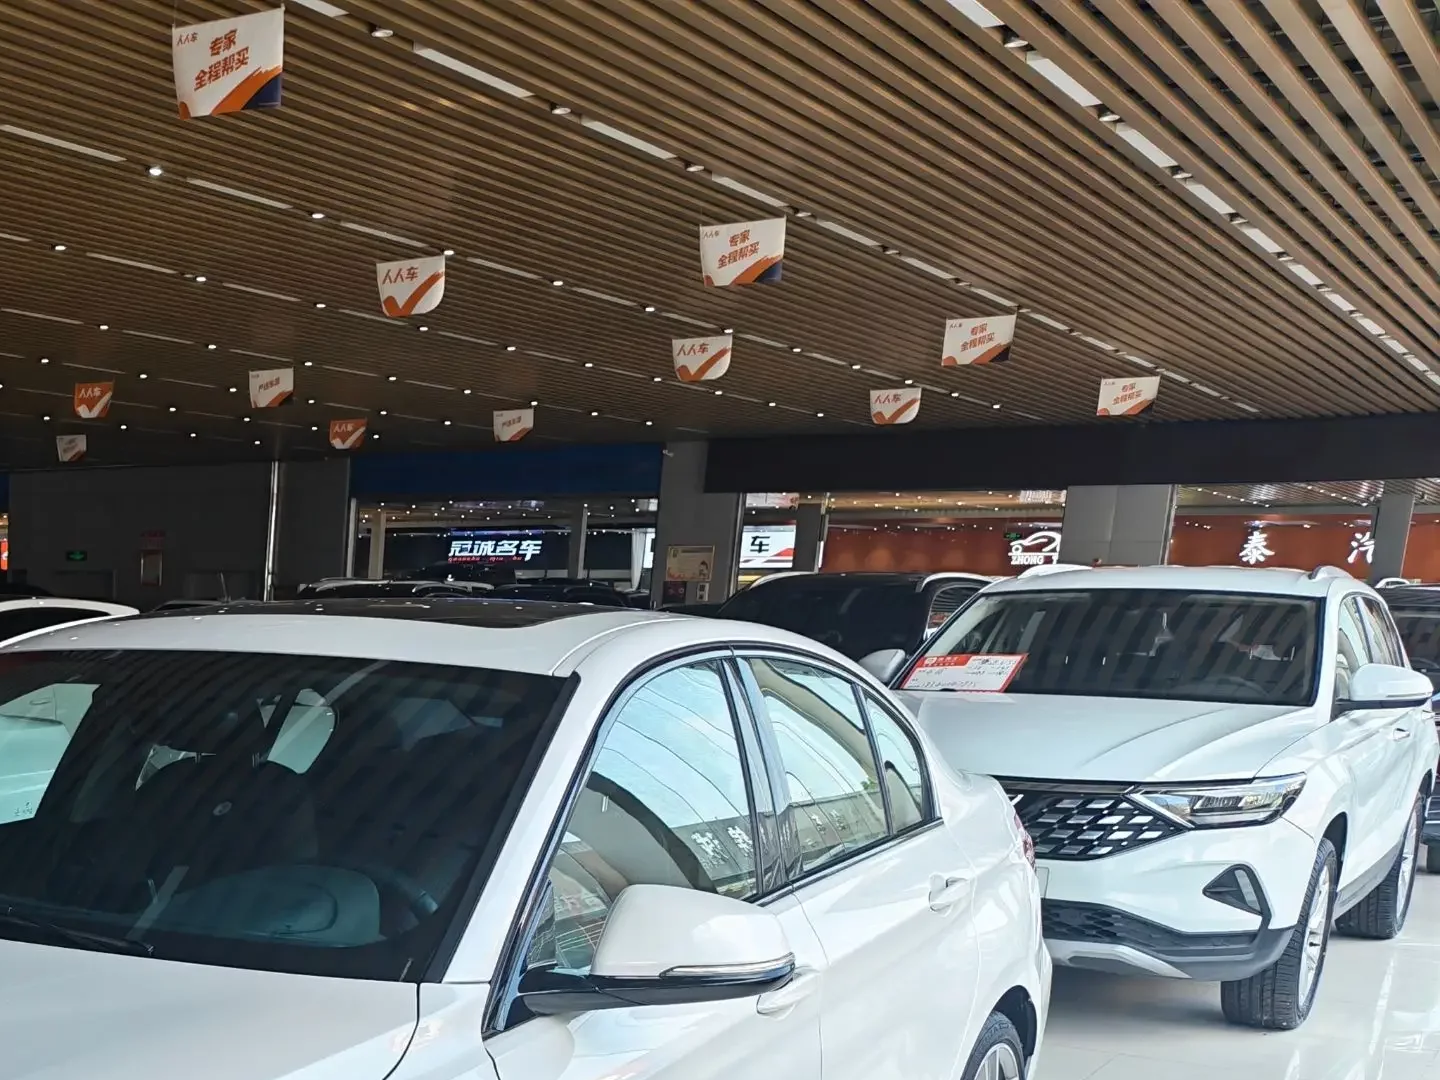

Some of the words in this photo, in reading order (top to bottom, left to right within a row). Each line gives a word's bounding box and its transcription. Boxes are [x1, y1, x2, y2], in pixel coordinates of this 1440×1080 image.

[209, 29, 238, 56] 专家
[194, 47, 250, 91] 全程帮买
[729, 229, 750, 247] 专家
[717, 241, 760, 269] 全程帮买
[382, 266, 419, 284] 人人车
[677, 343, 710, 356] 人人车
[79, 386, 102, 398] 人人车
[874, 393, 902, 404] 人人车
[447, 540, 543, 562] 冠诚名车
[750, 535, 771, 553] 车
[1010, 555, 1045, 565] ZHONG
